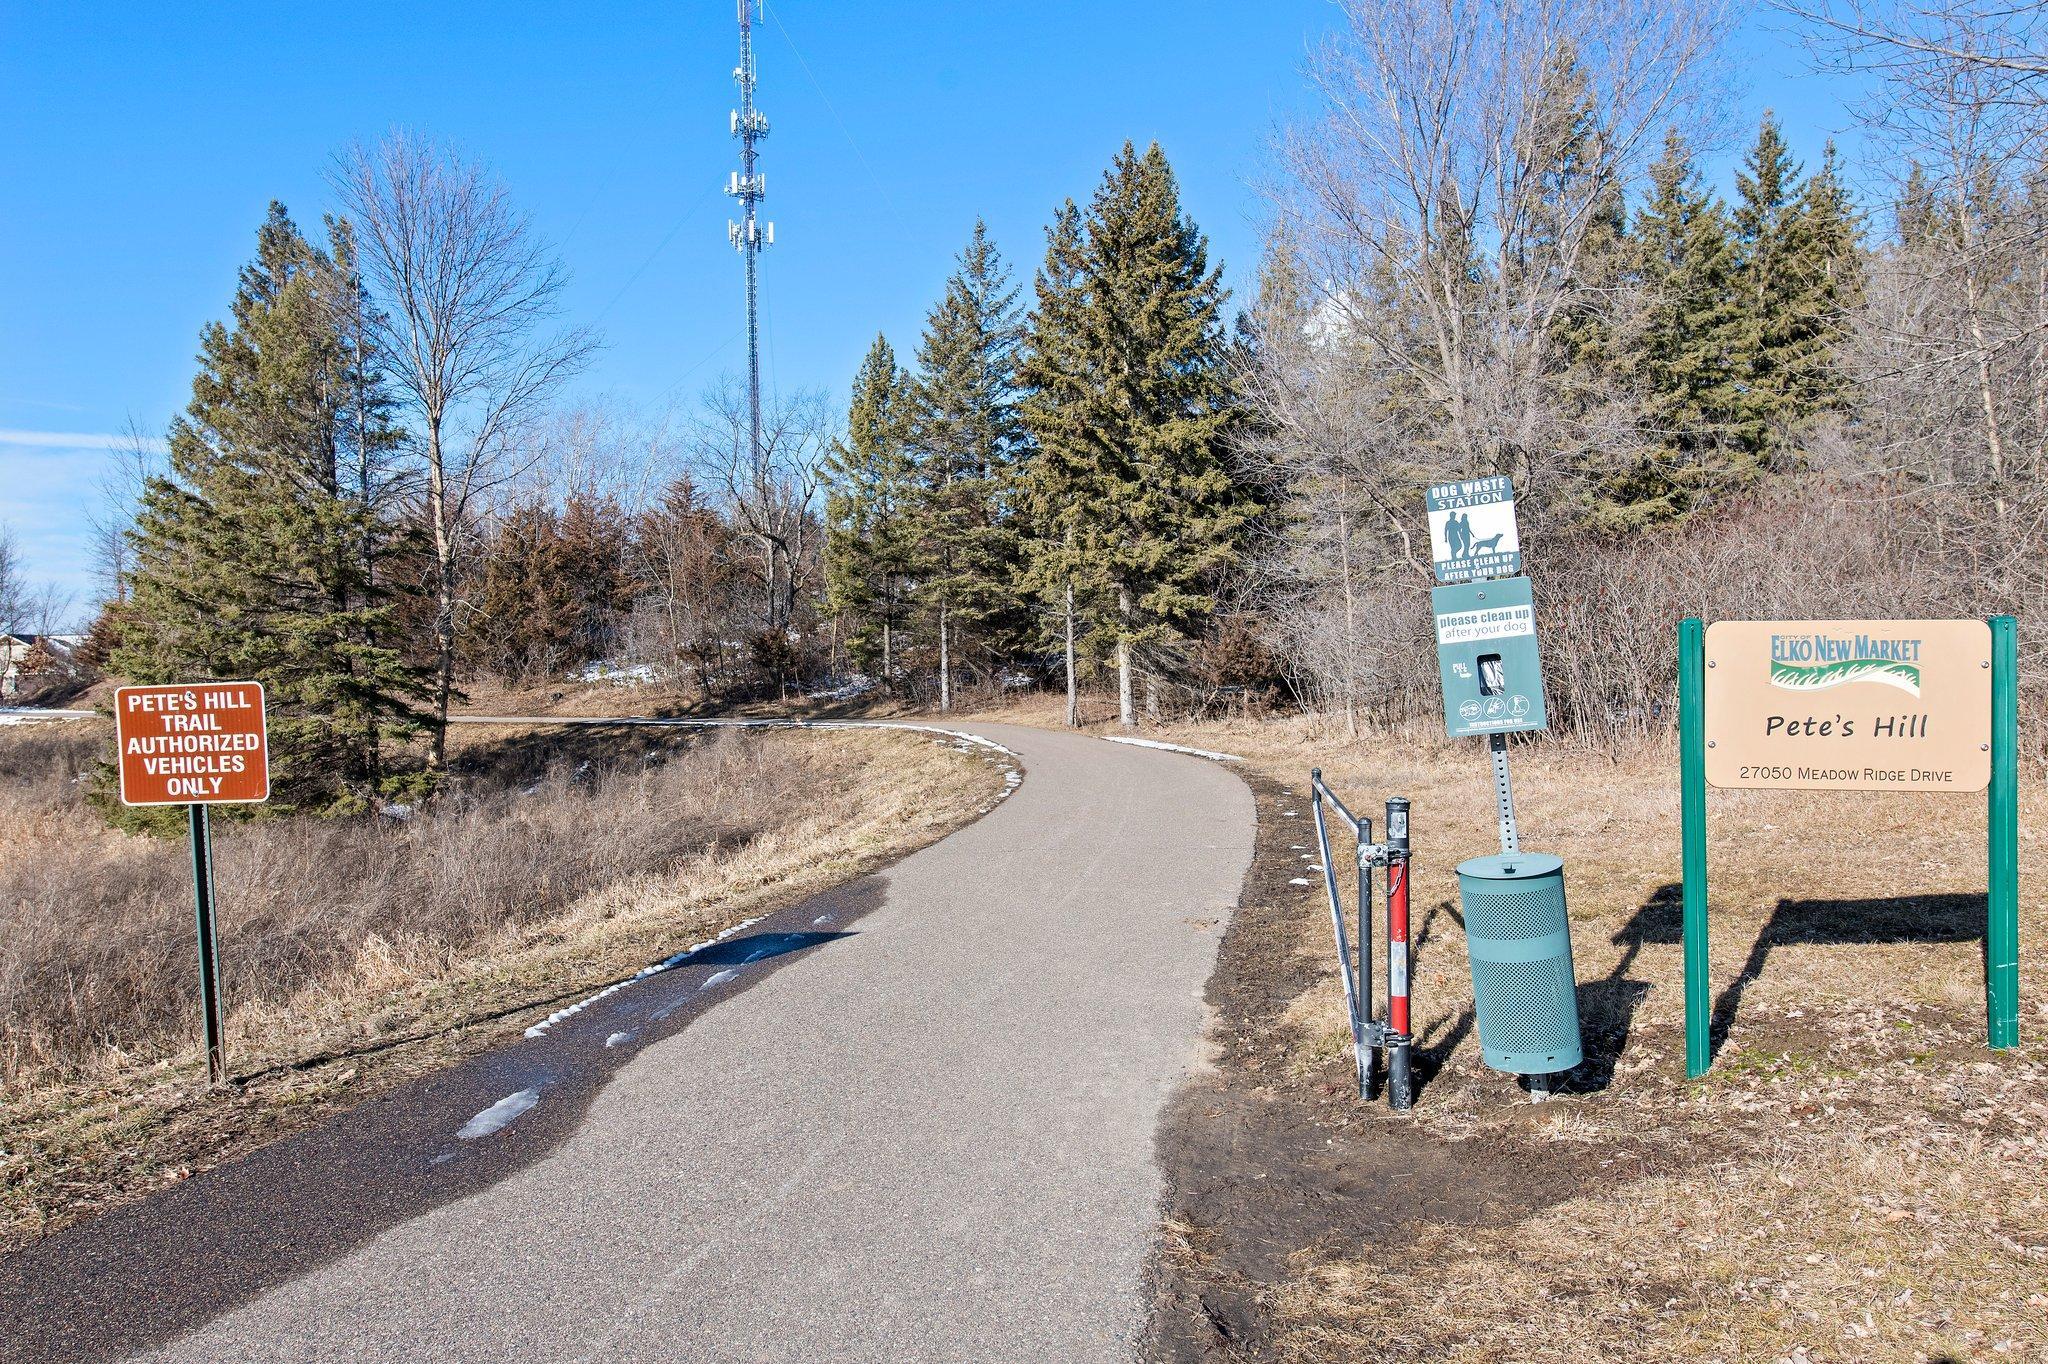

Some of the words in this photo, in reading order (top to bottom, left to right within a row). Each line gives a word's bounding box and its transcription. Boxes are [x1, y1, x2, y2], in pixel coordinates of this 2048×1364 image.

[1432, 485, 1457, 499] DOG
[1461, 478, 1505, 494] WASTE
[1438, 492, 1502, 510] STATION
[1441, 560, 1471, 570] PLEASE
[1473, 556, 1500, 566] CLEAN
[1502, 554, 1514, 562] UP
[1444, 570, 1469, 581] AFTER
[1471, 567, 1494, 577] YOUR
[1496, 565, 1514, 574] DOG
[1440, 614, 1477, 628] please
[1481, 611, 1512, 623] clean
[1515, 609, 1529, 619] up
[1445, 628, 1472, 639] after
[1474, 624, 1500, 637] your
[1503, 621, 1527, 633] dog
[127, 691, 197, 712] PETE'S
[205, 692, 251, 710] HILL
[161, 714, 222, 732] TRAIL
[1766, 715, 1854, 737] Pete's
[1874, 714, 1928, 738] Hill
[127, 734, 259, 755] AUTHORIZED
[144, 755, 245, 775] VEHICLES
[1740, 766, 1792, 779] 27050
[1798, 767, 1858, 780] MEADOW
[1864, 769, 1905, 781] RIDGE
[1911, 769, 1953, 782] DRIVE
[167, 777, 223, 796] ONLY
